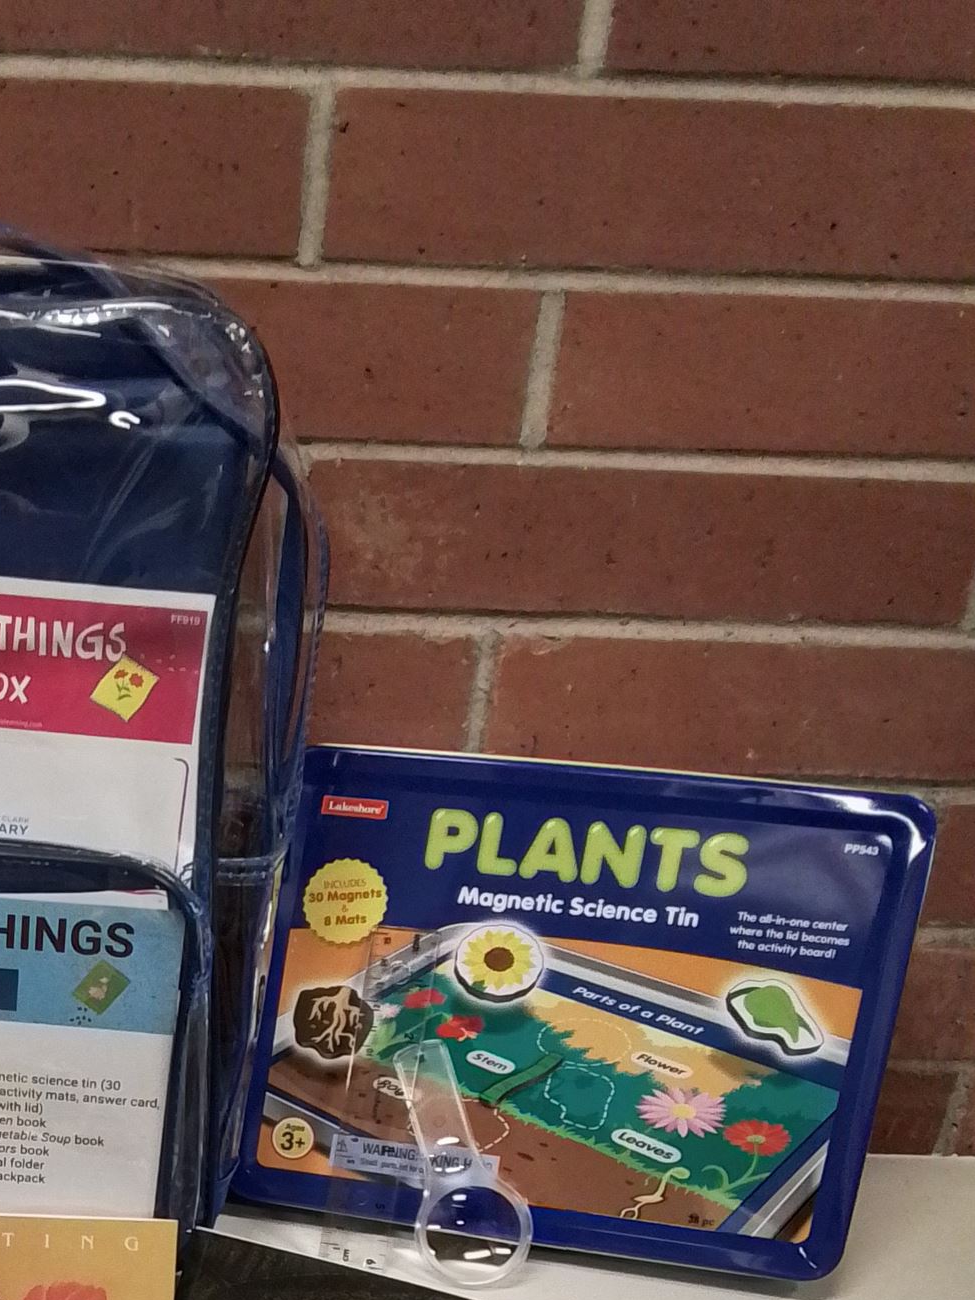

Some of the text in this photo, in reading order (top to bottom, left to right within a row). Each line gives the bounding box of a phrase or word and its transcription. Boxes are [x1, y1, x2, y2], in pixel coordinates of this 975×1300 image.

[328, 801, 382, 814] Lakeshore
[424, 807, 750, 898] PLANTS
[844, 843, 879, 856] PP543
[324, 879, 367, 889] INCLUDES
[308, 889, 382, 903] 30 Magnets
[457, 885, 699, 928] Magnetic Science Tin
[324, 914, 367, 926] 8 Mats
[737, 911, 848, 932] The all-in-one center
[729, 926, 850, 946] where the lid becomes
[737, 939, 836, 959] the activity board!
[572, 986, 706, 1037] Parts of a Plant
[473, 1053, 509, 1072] Stem
[636, 1053, 687, 1077] Flower
[31, 1074, 78, 1087] science
[81, 1078, 97, 1089] tin
[100, 1079, 121, 1092] (30
[0, 1086, 42, 1100] activity
[45, 1091, 79, 1103] mats,
[82, 1094, 127, 1106] answer
[130, 1097, 160, 1110] card,
[24, 1102, 43, 1115] lid)
[16, 1117, 46, 1128] book
[285, 1123, 305, 1132] Ages
[41, 1132, 71, 1146] Soup
[74, 1134, 104, 1147] book
[281, 1132, 306, 1151] 3+
[618, 1131, 674, 1161] Leaves
[20, 1144, 49, 1157] book
[10, 1157, 44, 1170] folder
[701, 1217, 715, 1227] pc
[343, 1248, 350, 1262] cm
